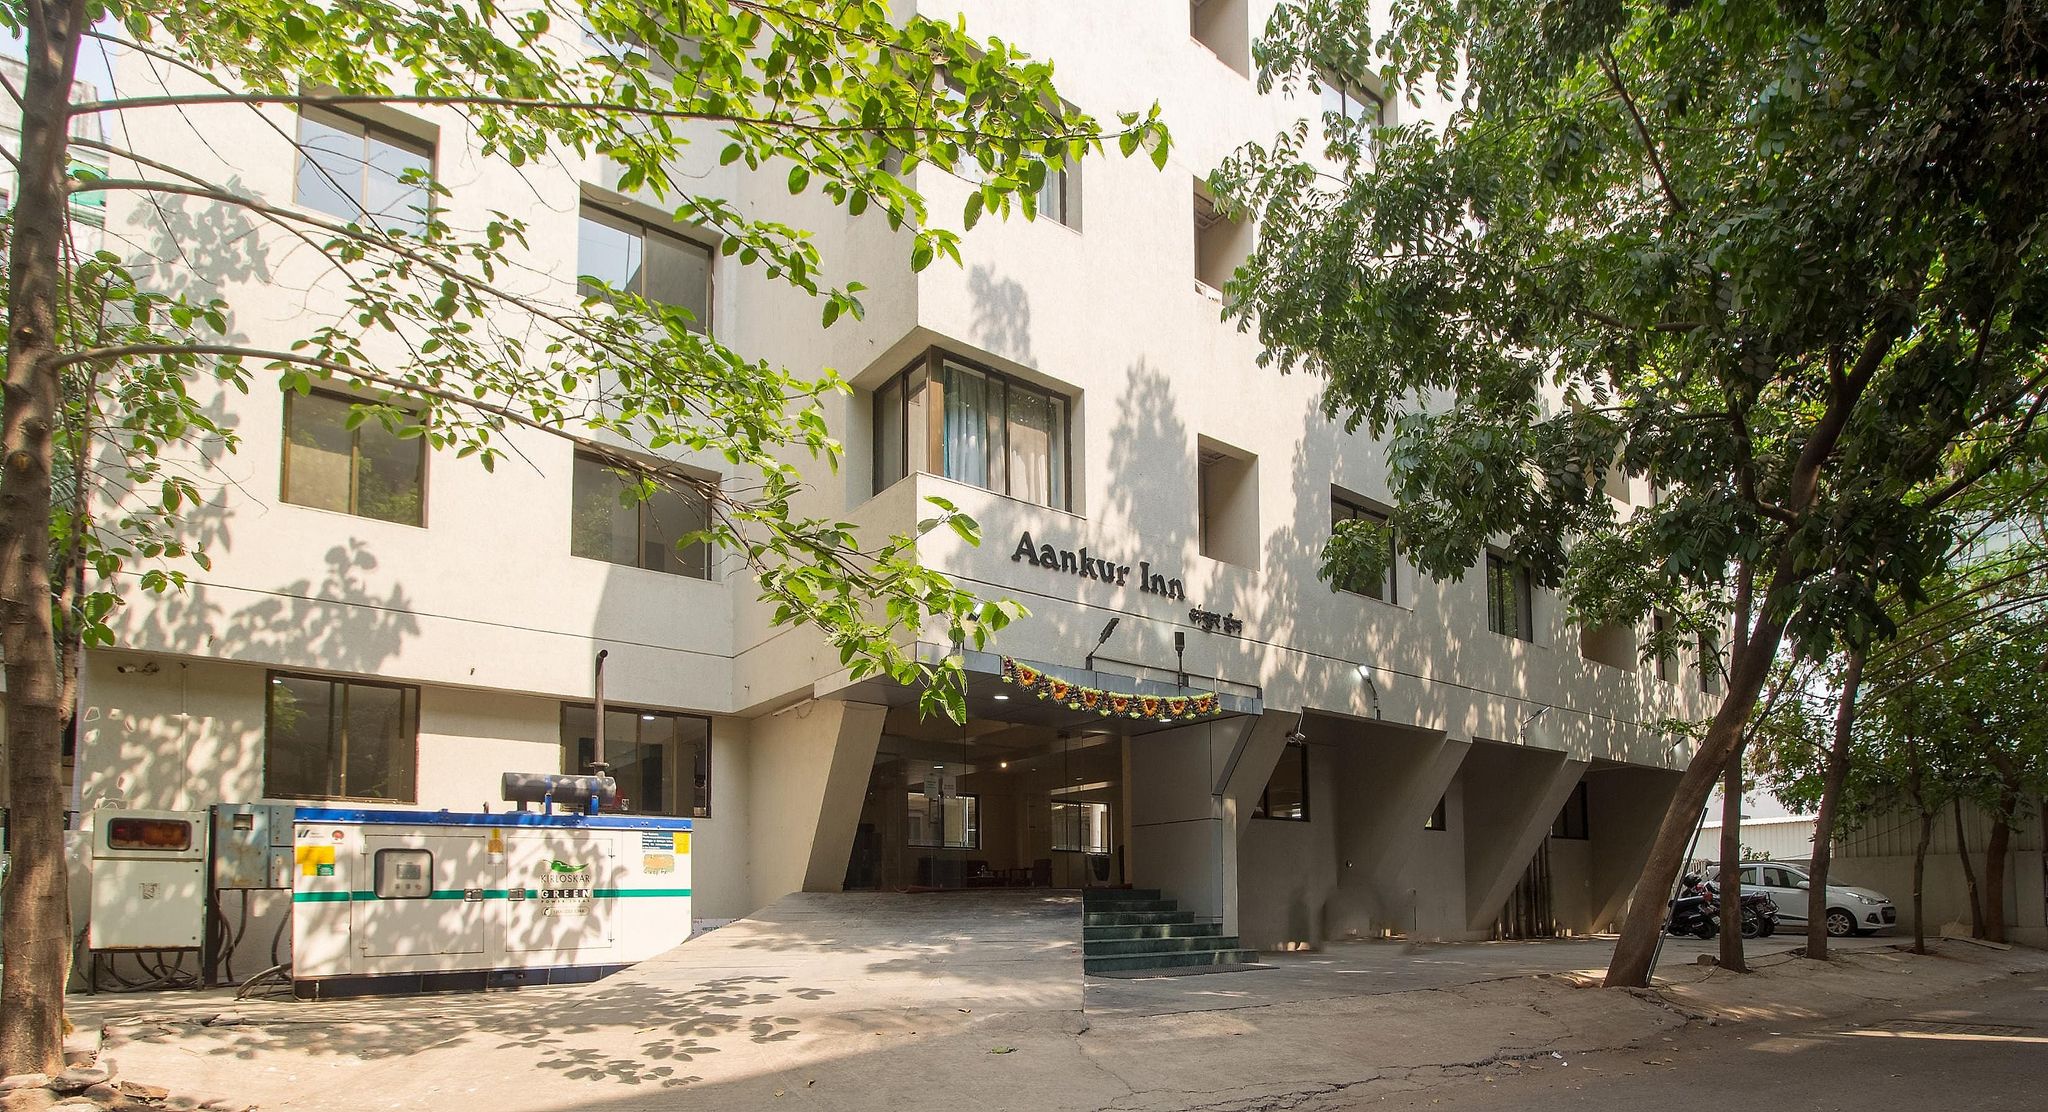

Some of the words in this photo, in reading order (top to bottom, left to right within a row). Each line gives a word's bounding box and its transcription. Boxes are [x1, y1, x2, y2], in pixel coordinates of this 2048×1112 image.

[1011, 531, 1130, 587] Aankur
[1139, 561, 1186, 601] Inn
[540, 874, 590, 883] KIRLOSKAR
[541, 889, 590, 899] GREEN
